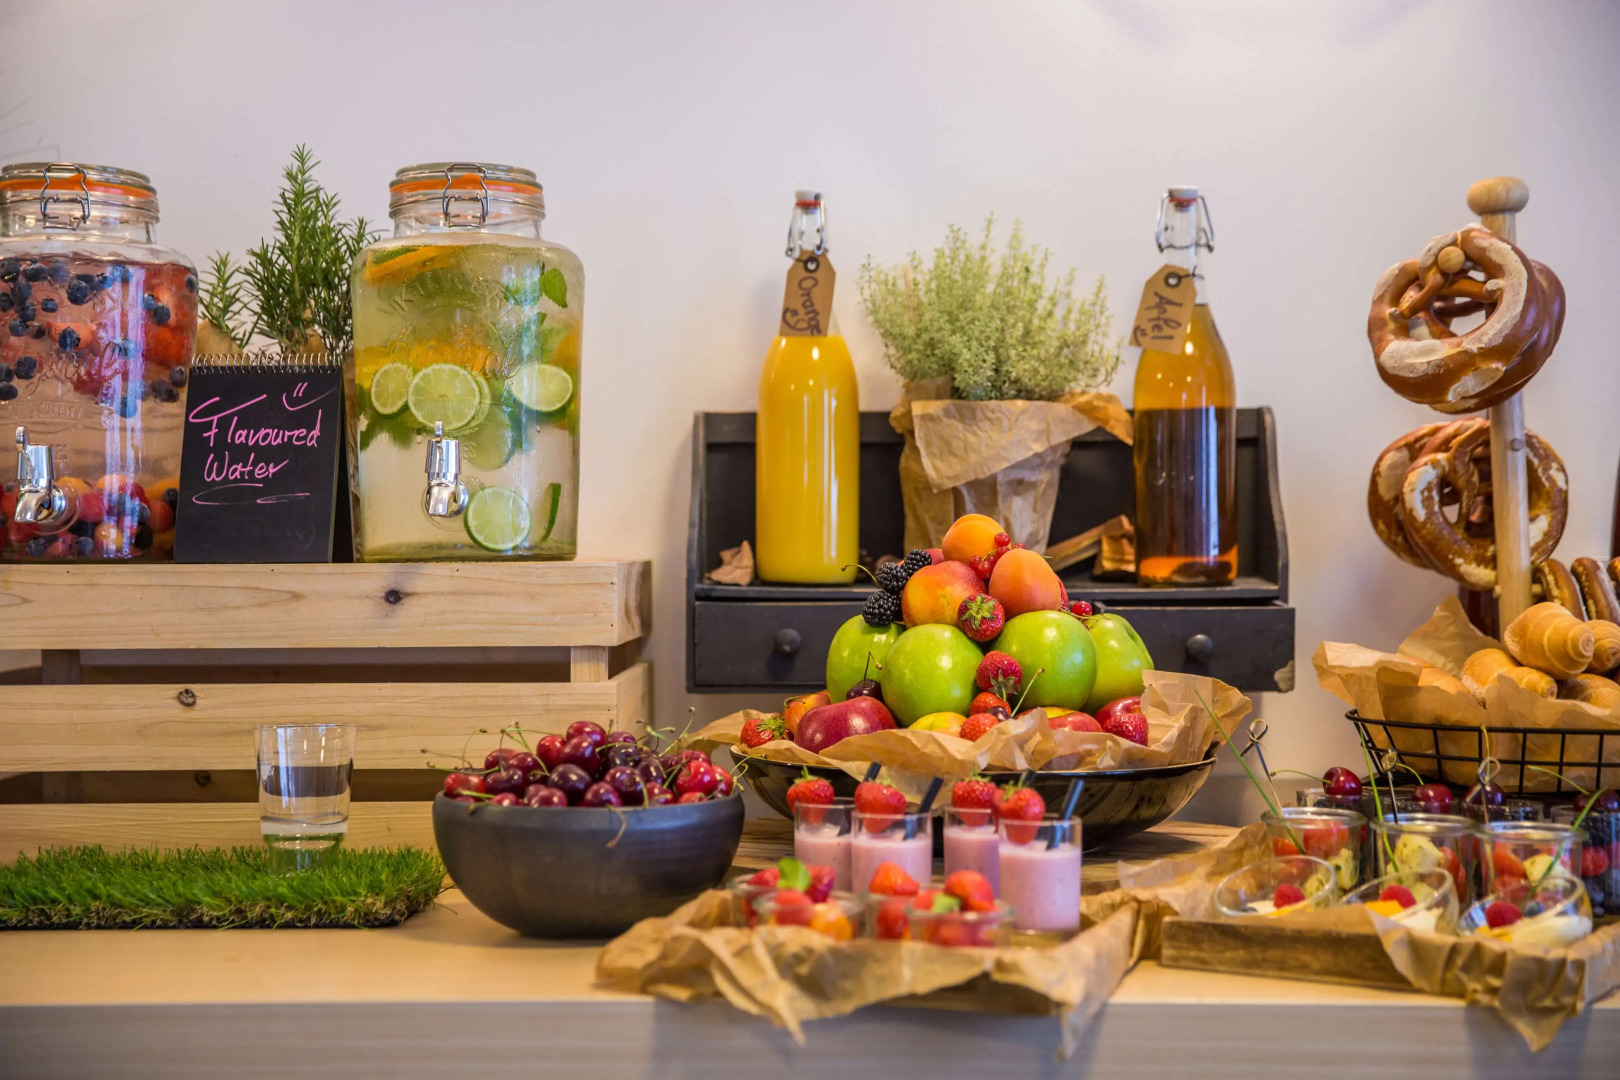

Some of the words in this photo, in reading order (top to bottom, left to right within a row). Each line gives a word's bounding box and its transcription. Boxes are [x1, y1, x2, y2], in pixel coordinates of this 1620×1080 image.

[785, 275, 822, 337] Orange
[1144, 290, 1184, 340] Apfel
[189, 393, 322, 448] Flavoured
[204, 450, 290, 482] Water
